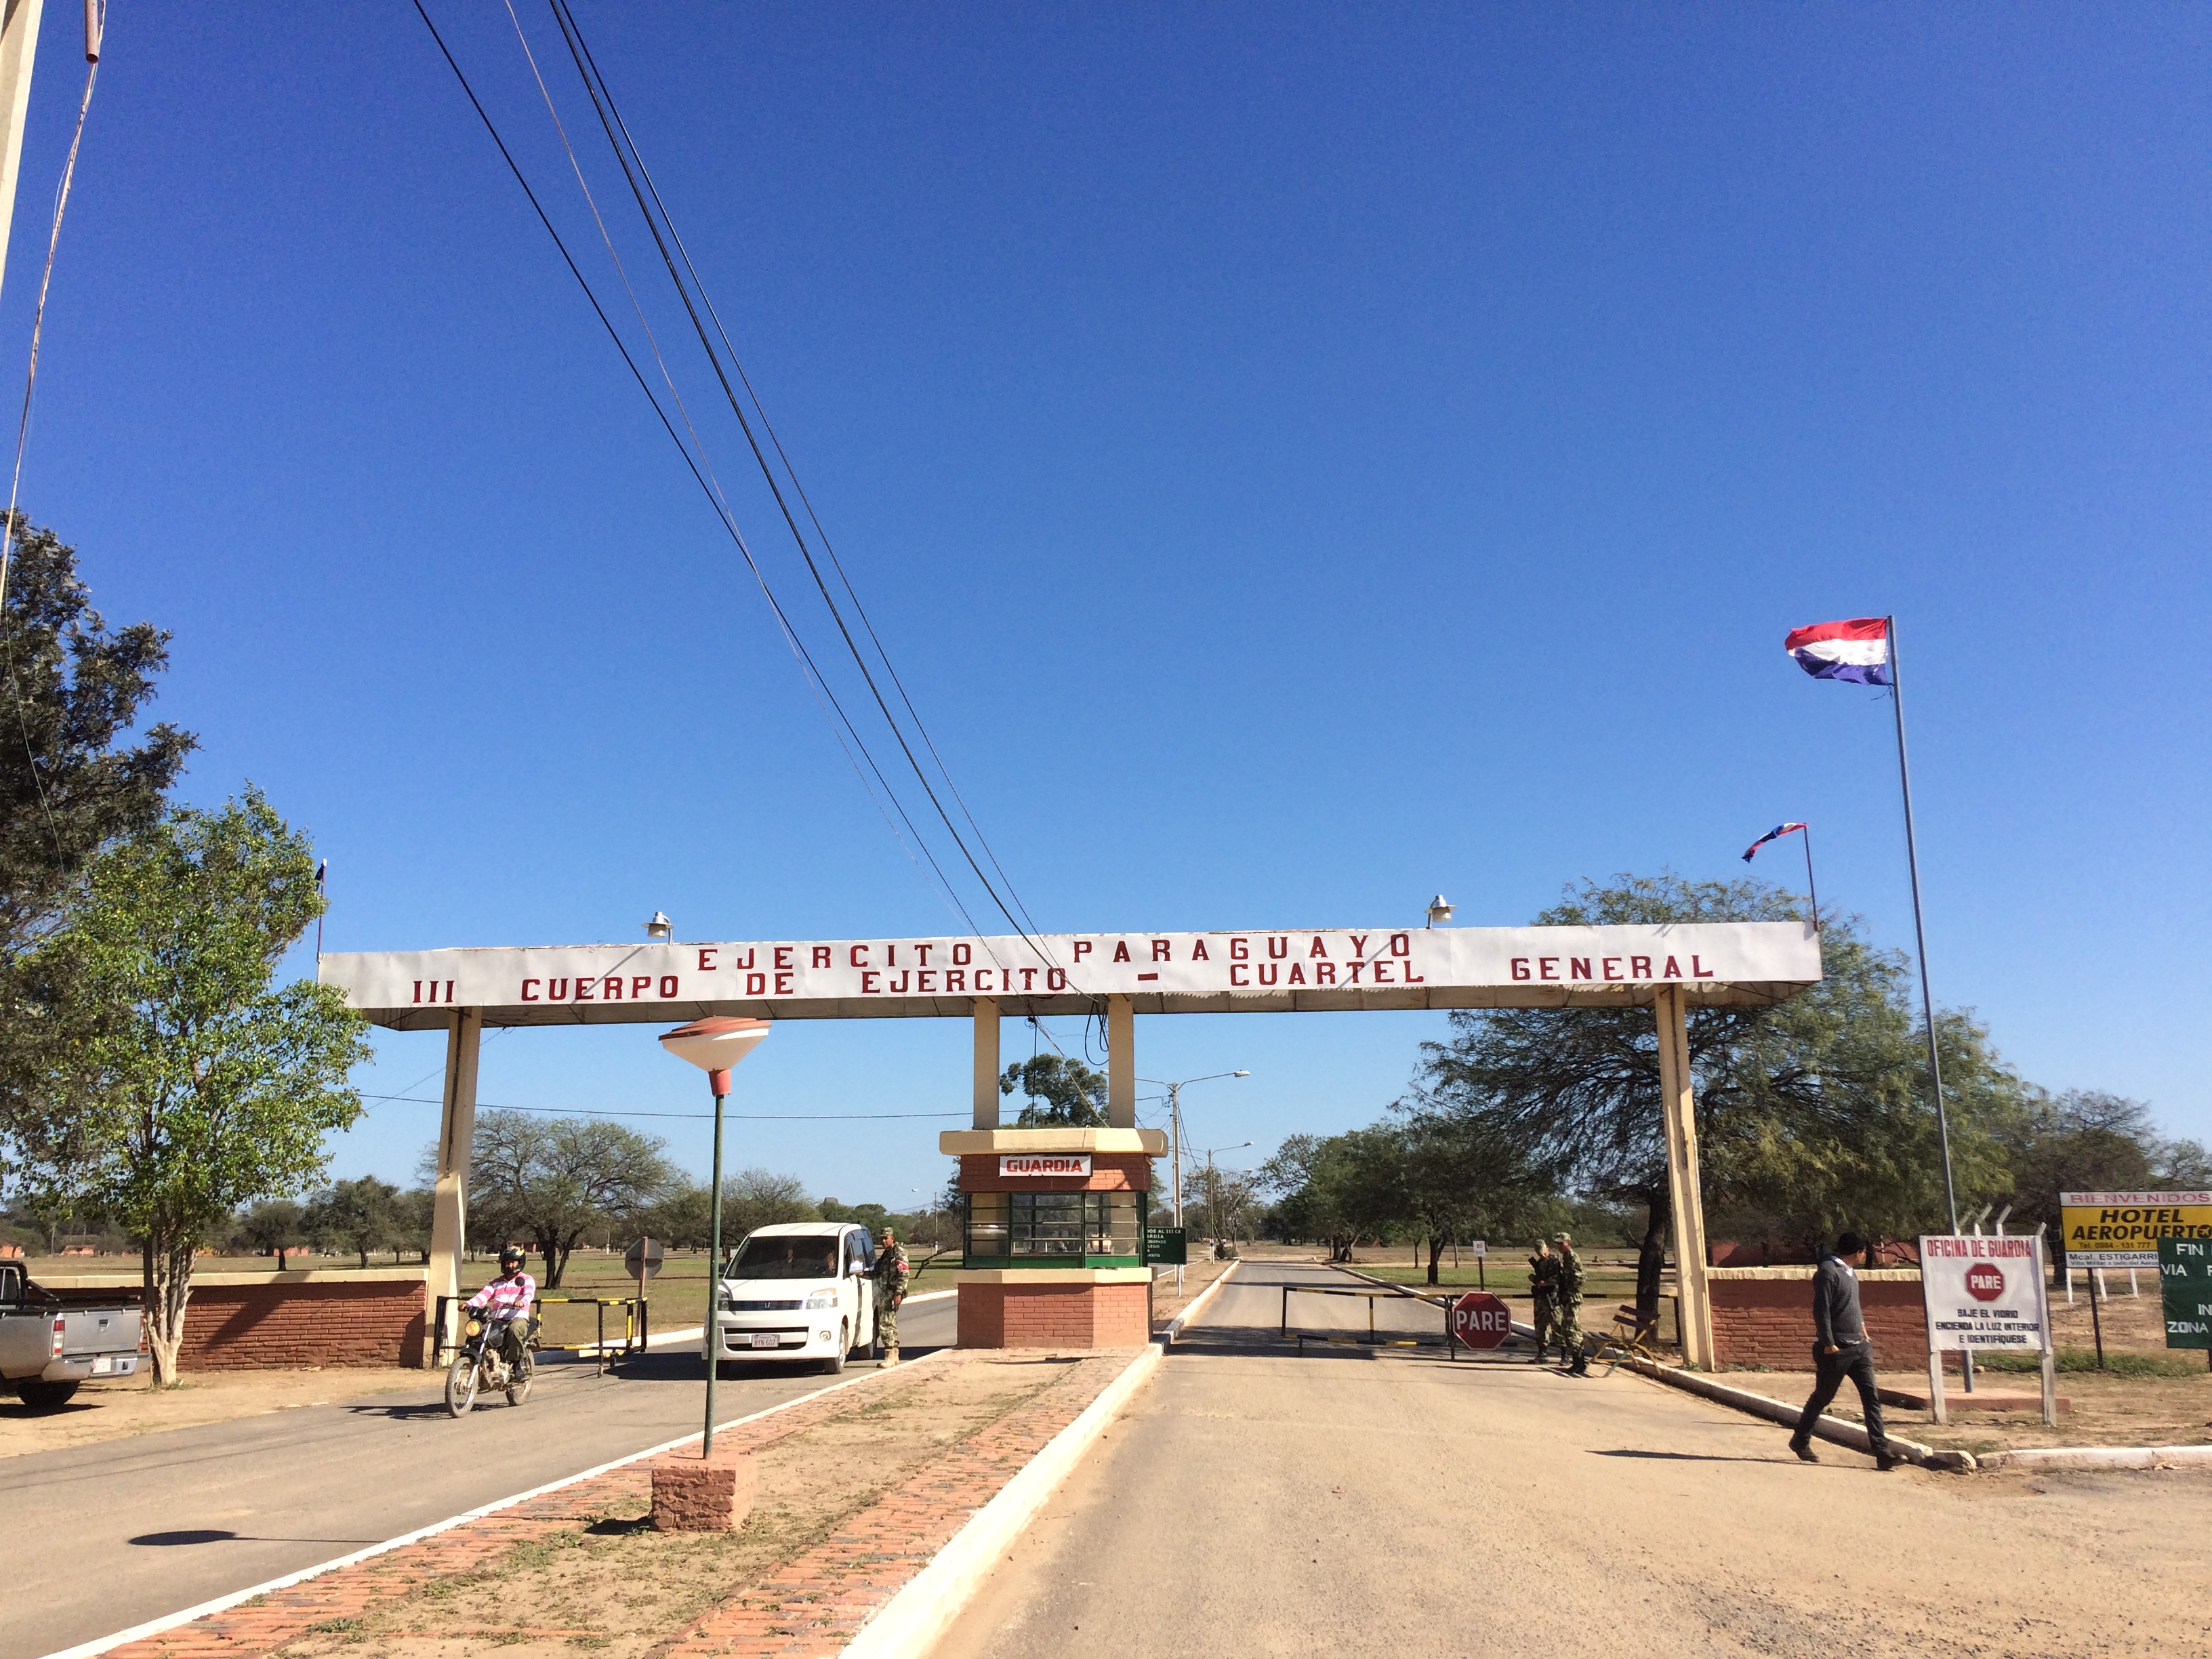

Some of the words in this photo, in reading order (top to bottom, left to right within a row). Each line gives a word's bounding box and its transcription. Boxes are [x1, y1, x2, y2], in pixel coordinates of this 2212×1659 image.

[698, 943, 971, 971] EJERCITO
[1073, 933, 1410, 963] PARAGUAYO
[412, 980, 455, 1003] III
[521, 975, 678, 1001] CUERPO
[745, 972, 794, 995] DE
[861, 968, 1066, 994] EJERCITO
[1230, 960, 1424, 986] CUARTEL
[1511, 955, 1714, 981] GENERAL
[1006, 1160, 1083, 1172] GUARDIA
[2070, 1193, 2211, 1204] BIENVENIDOS
[2100, 1209, 2184, 1223] HOTEL
[1927, 1240, 1968, 1257] OFICINA
[1971, 1240, 1985, 1257] DE
[1988, 1240, 2032, 1258] GUARDIA
[2176, 1243, 2204, 1256] FIN
[2160, 1263, 2188, 1277] VIA
[1971, 1275, 2001, 1289] PARE
[1957, 1309, 1978, 1317] BAJE
[1980, 1309, 1990, 1318] EL
[1993, 1309, 2018, 1319] VIDRIO
[1456, 1310, 1507, 1332] PARE
[1936, 1322, 1973, 1331] ENCIENDA
[1975, 1322, 1984, 1331] LA
[1986, 1322, 2002, 1331] LUZ
[2004, 1323, 2040, 1332] INTERIOR
[2167, 1321, 2209, 1334] ZONA
[1959, 1334, 1965, 1343] E
